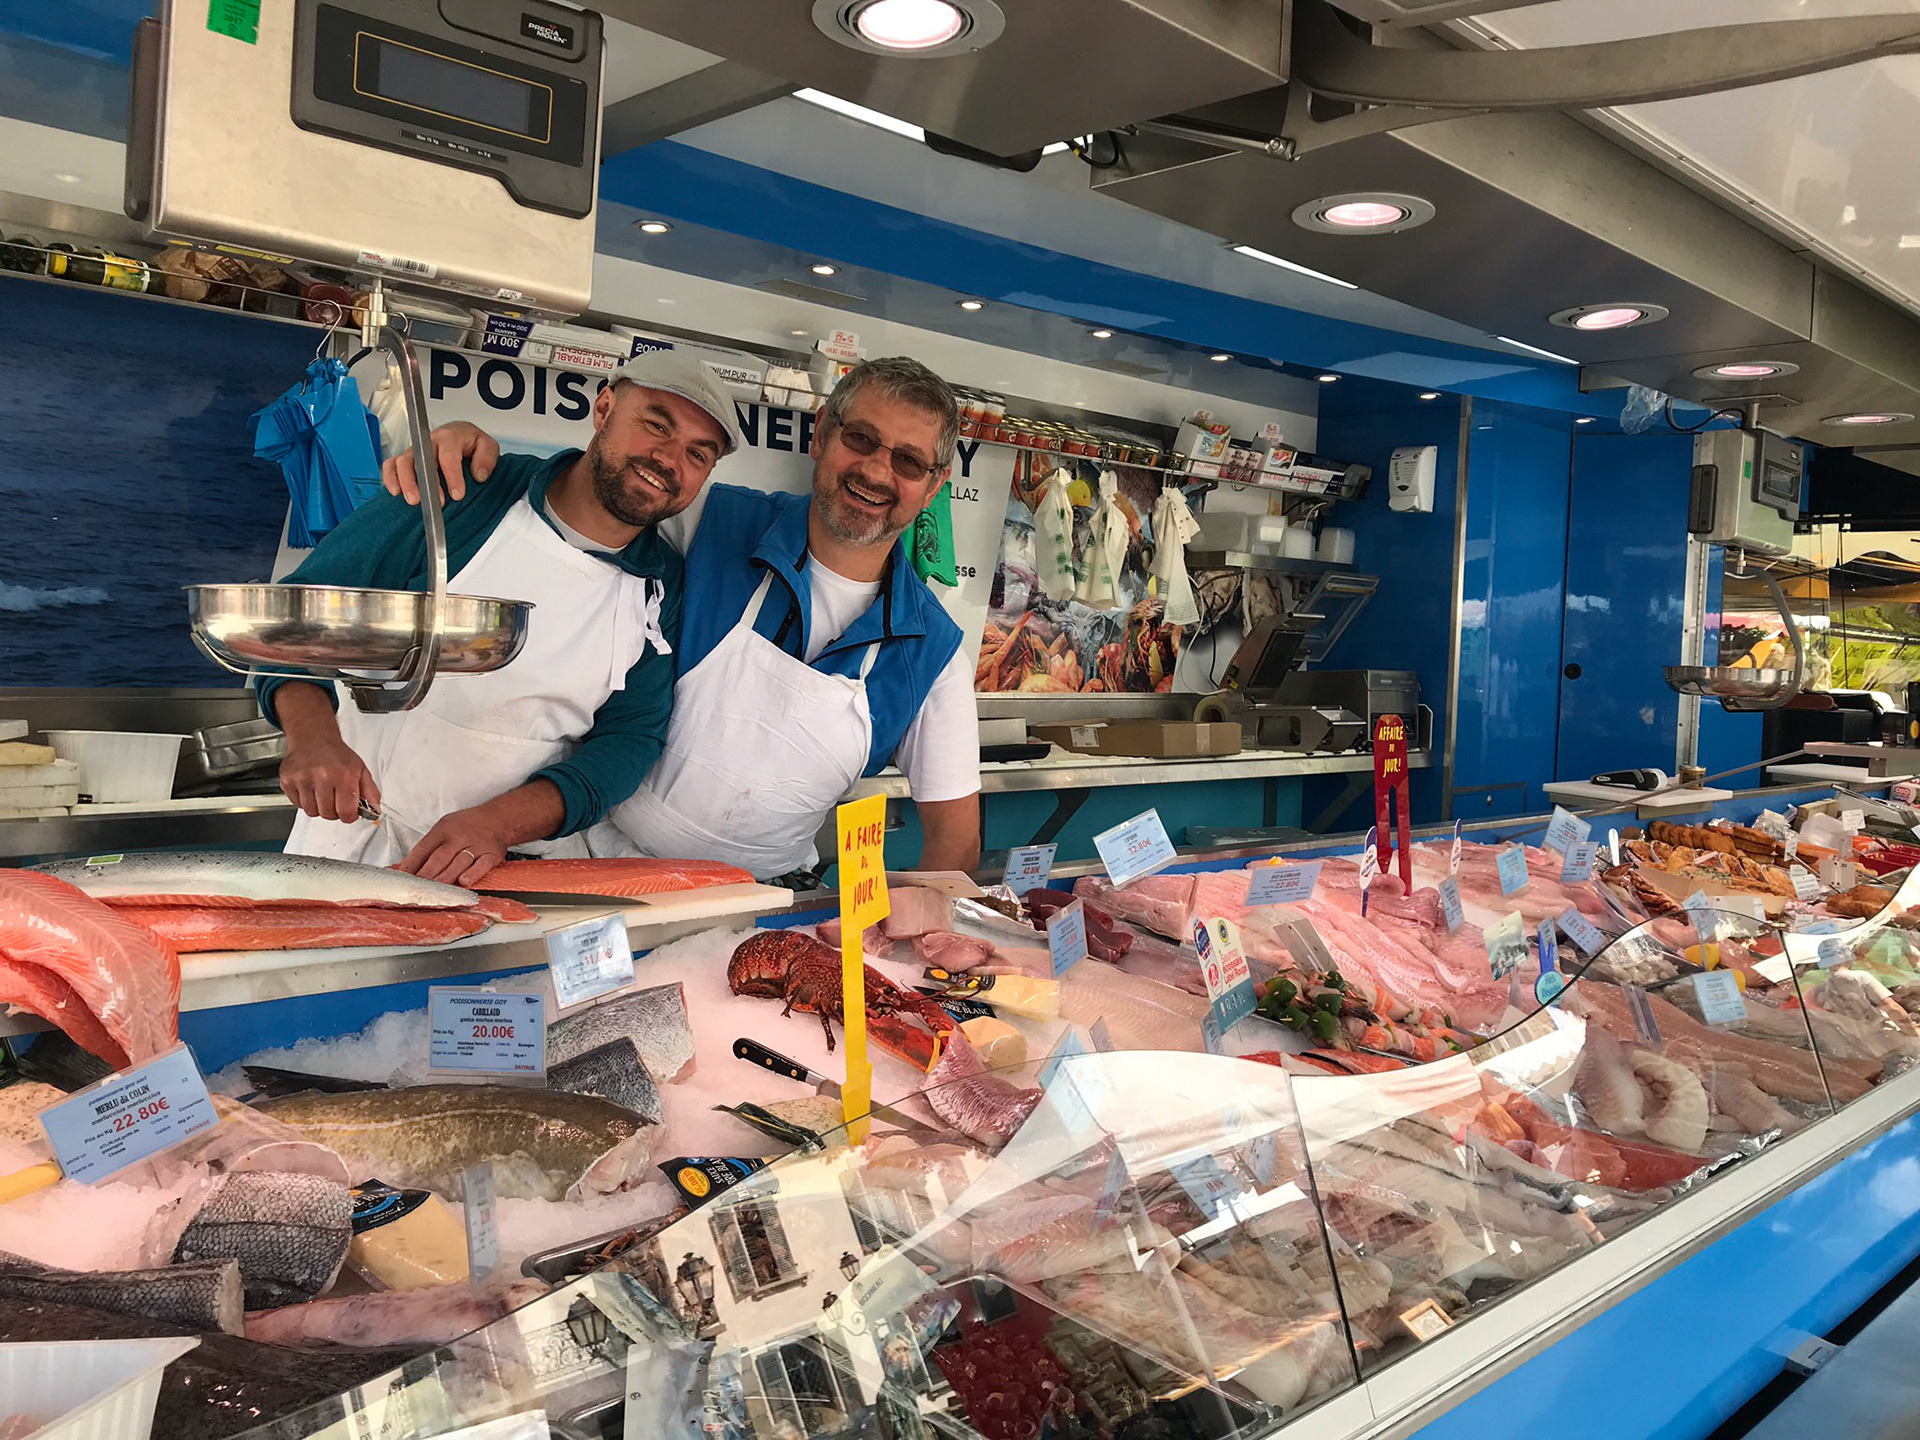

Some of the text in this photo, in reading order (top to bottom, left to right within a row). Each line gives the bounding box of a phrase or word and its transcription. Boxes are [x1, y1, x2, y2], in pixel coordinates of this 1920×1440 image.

[528, 22, 559, 37] PRECIA
[536, 31, 565, 44] MOLEN
[500, 337, 520, 348] 300
[553, 351, 614, 370] FILM ETIRABL
[731, 370, 747, 379] PUR
[955, 565, 976, 578] sse
[1379, 726, 1404, 741] AFFAIRE
[845, 821, 882, 852] A FAIRE
[1223, 964, 1248, 985] Label Rouge
[472, 1008, 501, 1016] CABILLAUD
[962, 1007, 990, 1015] BLANC
[472, 1025, 515, 1039] 20.00€
[95, 1084, 150, 1115] MERLU dit COLIN
[91, 1091, 161, 1126] merluccius merluccius
[84, 1134, 96, 1144] Prix
[104, 1128, 113, 1137] Kg
[113, 1096, 170, 1132] 22.80€
[184, 1119, 211, 1135] SAUVAGE
